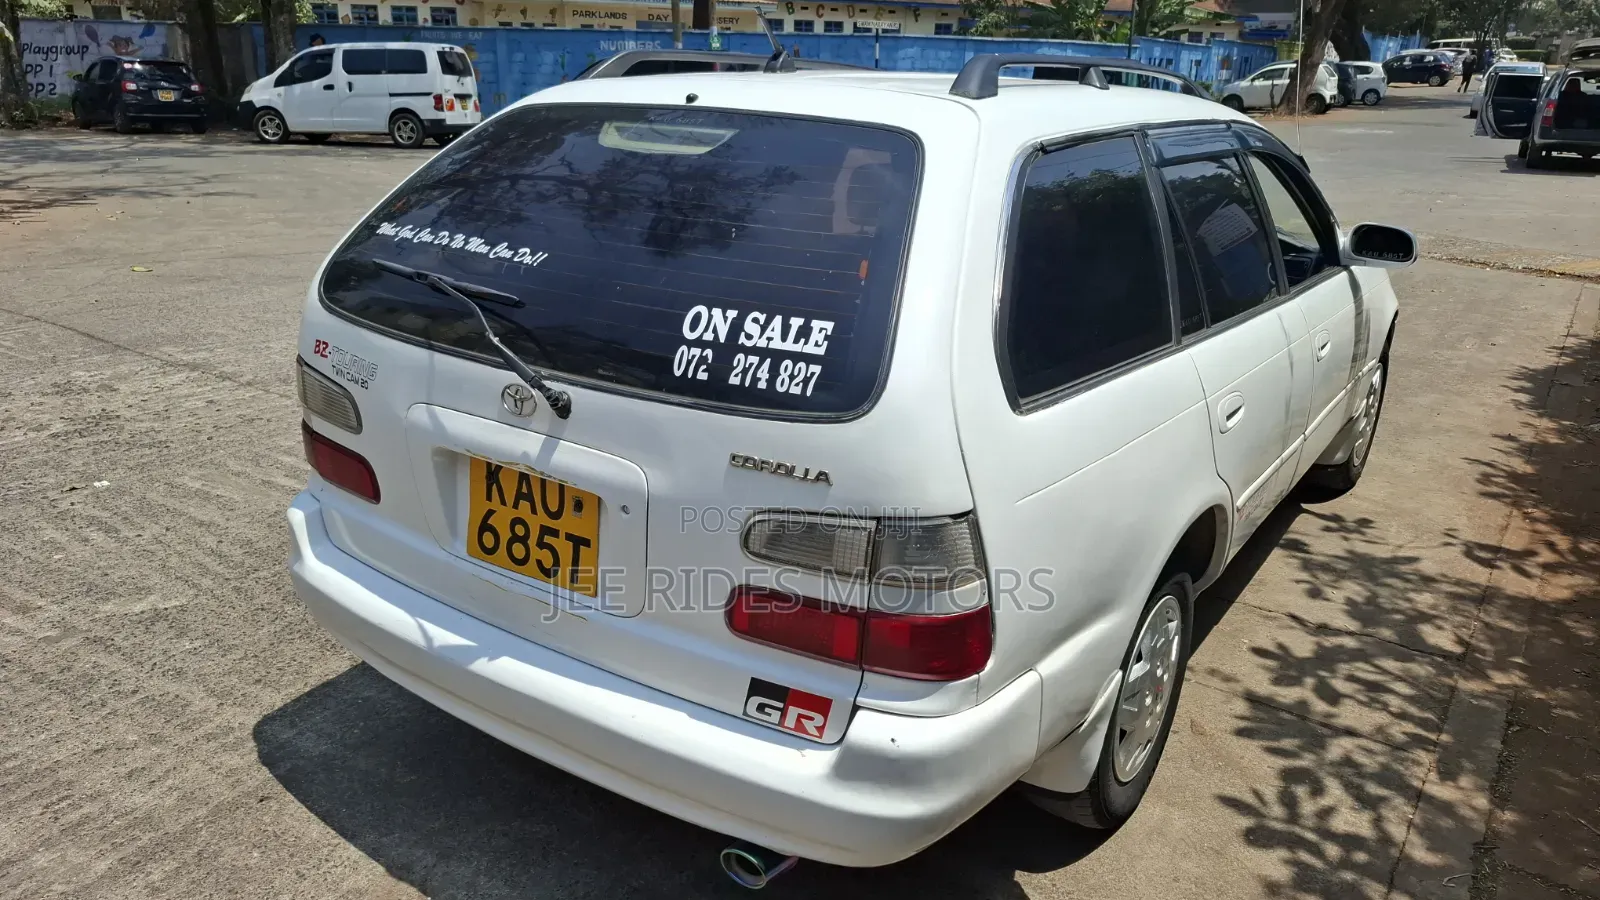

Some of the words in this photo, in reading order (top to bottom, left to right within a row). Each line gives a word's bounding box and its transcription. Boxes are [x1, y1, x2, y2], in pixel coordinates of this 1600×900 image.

[572, 10, 627, 20] PARKLANDS
[648, 13, 669, 21] DAY
[716, 17, 740, 25] SERY
[785, 0, 795, 15] B
[816, 4, 825, 18] C
[846, 4, 856, 19] D
[913, 8, 921, 22] F
[21, 43, 89, 61] Playgroup
[468, 31, 483, 40] EAT
[600, 40, 661, 50] NUMBERS
[48, 83, 57, 96] 2
[394, 225, 419, 241] God
[413, 228, 435, 243] Can
[433, 231, 450, 244] Do
[450, 233, 466, 248] No
[465, 237, 490, 254] Man
[489, 242, 514, 258] Can
[513, 248, 548, 266] Do!!
[682, 304, 739, 343] ON
[738, 311, 835, 355] SALE
[673, 345, 713, 380] 072
[728, 353, 771, 389] 274
[775, 359, 822, 397] 827
[730, 452, 833, 487] COROLLA
[485, 461, 566, 521] KAU
[477, 508, 592, 584] 685T
[746, 695, 825, 737] GR
